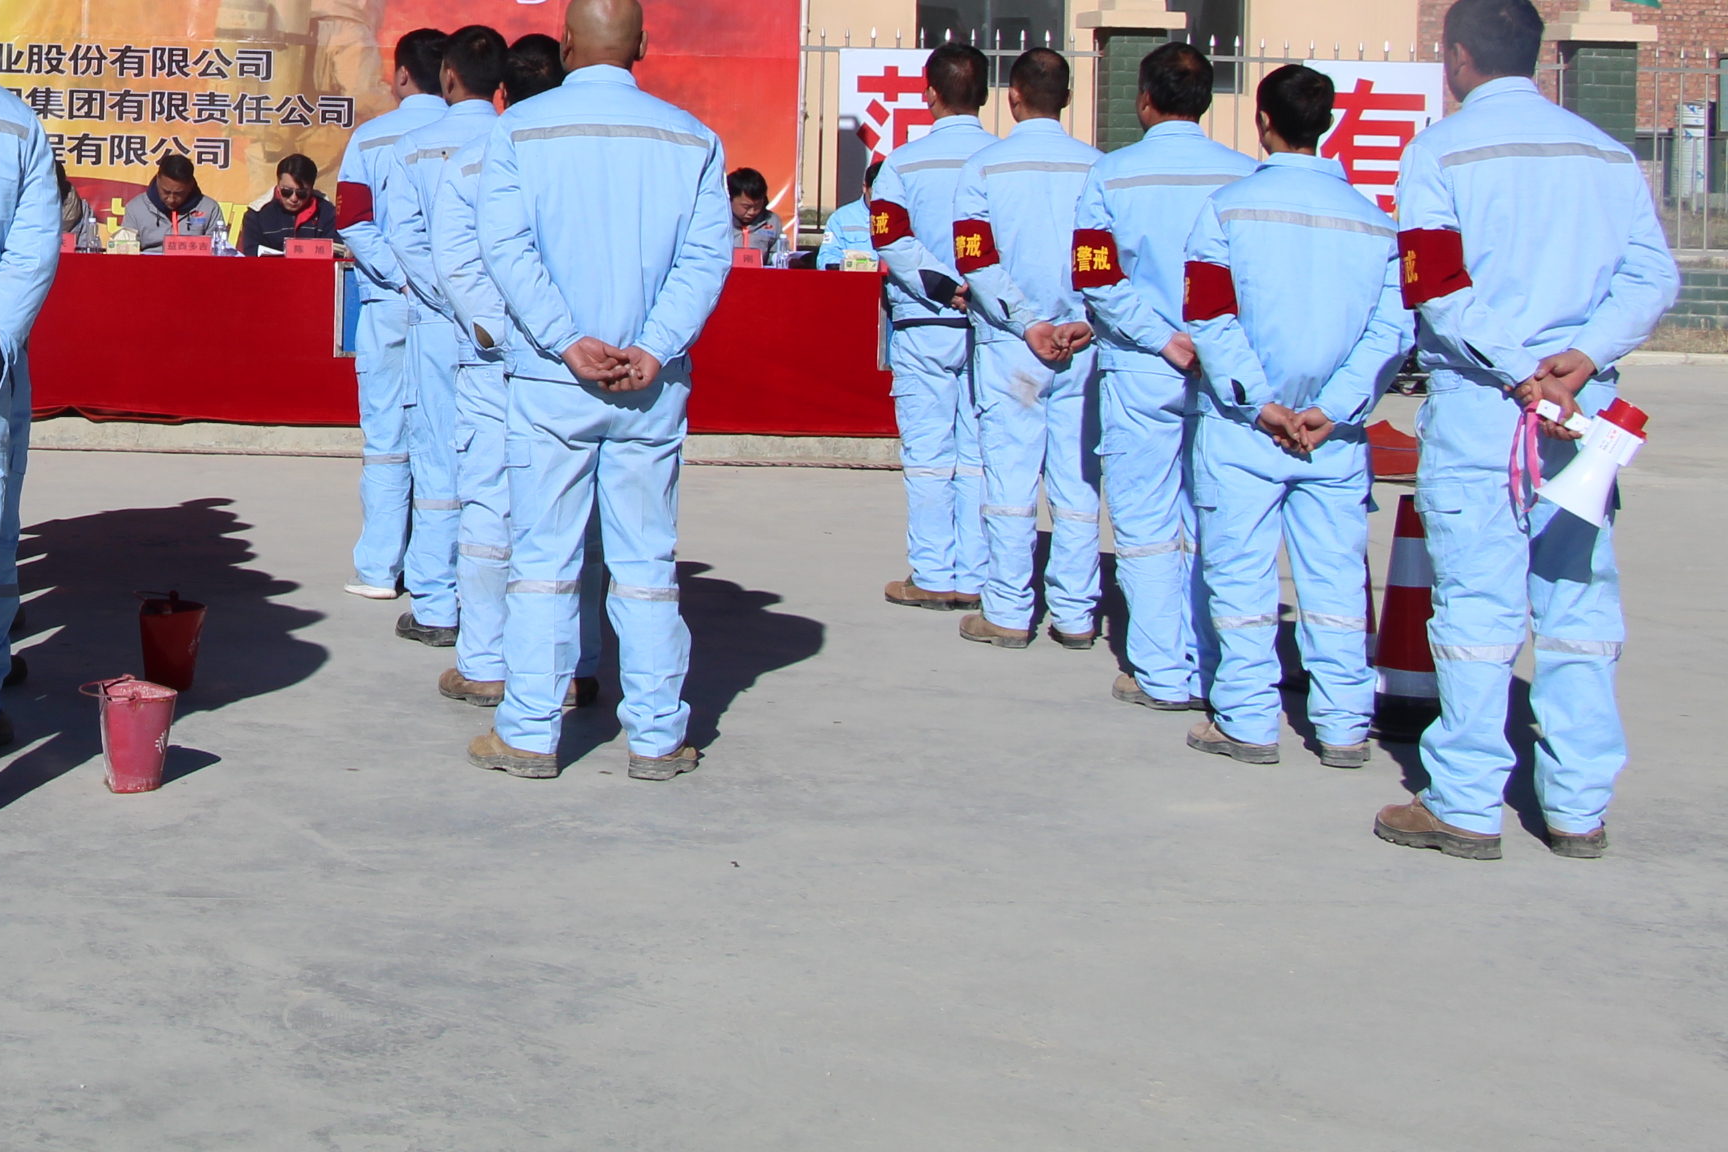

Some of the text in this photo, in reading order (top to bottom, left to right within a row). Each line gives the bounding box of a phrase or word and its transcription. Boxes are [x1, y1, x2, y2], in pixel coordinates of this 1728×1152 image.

[8, 86, 355, 129] 集团有限责任公司
[1320, 78, 1426, 214] 有
[1073, 245, 1111, 272] 警戒
